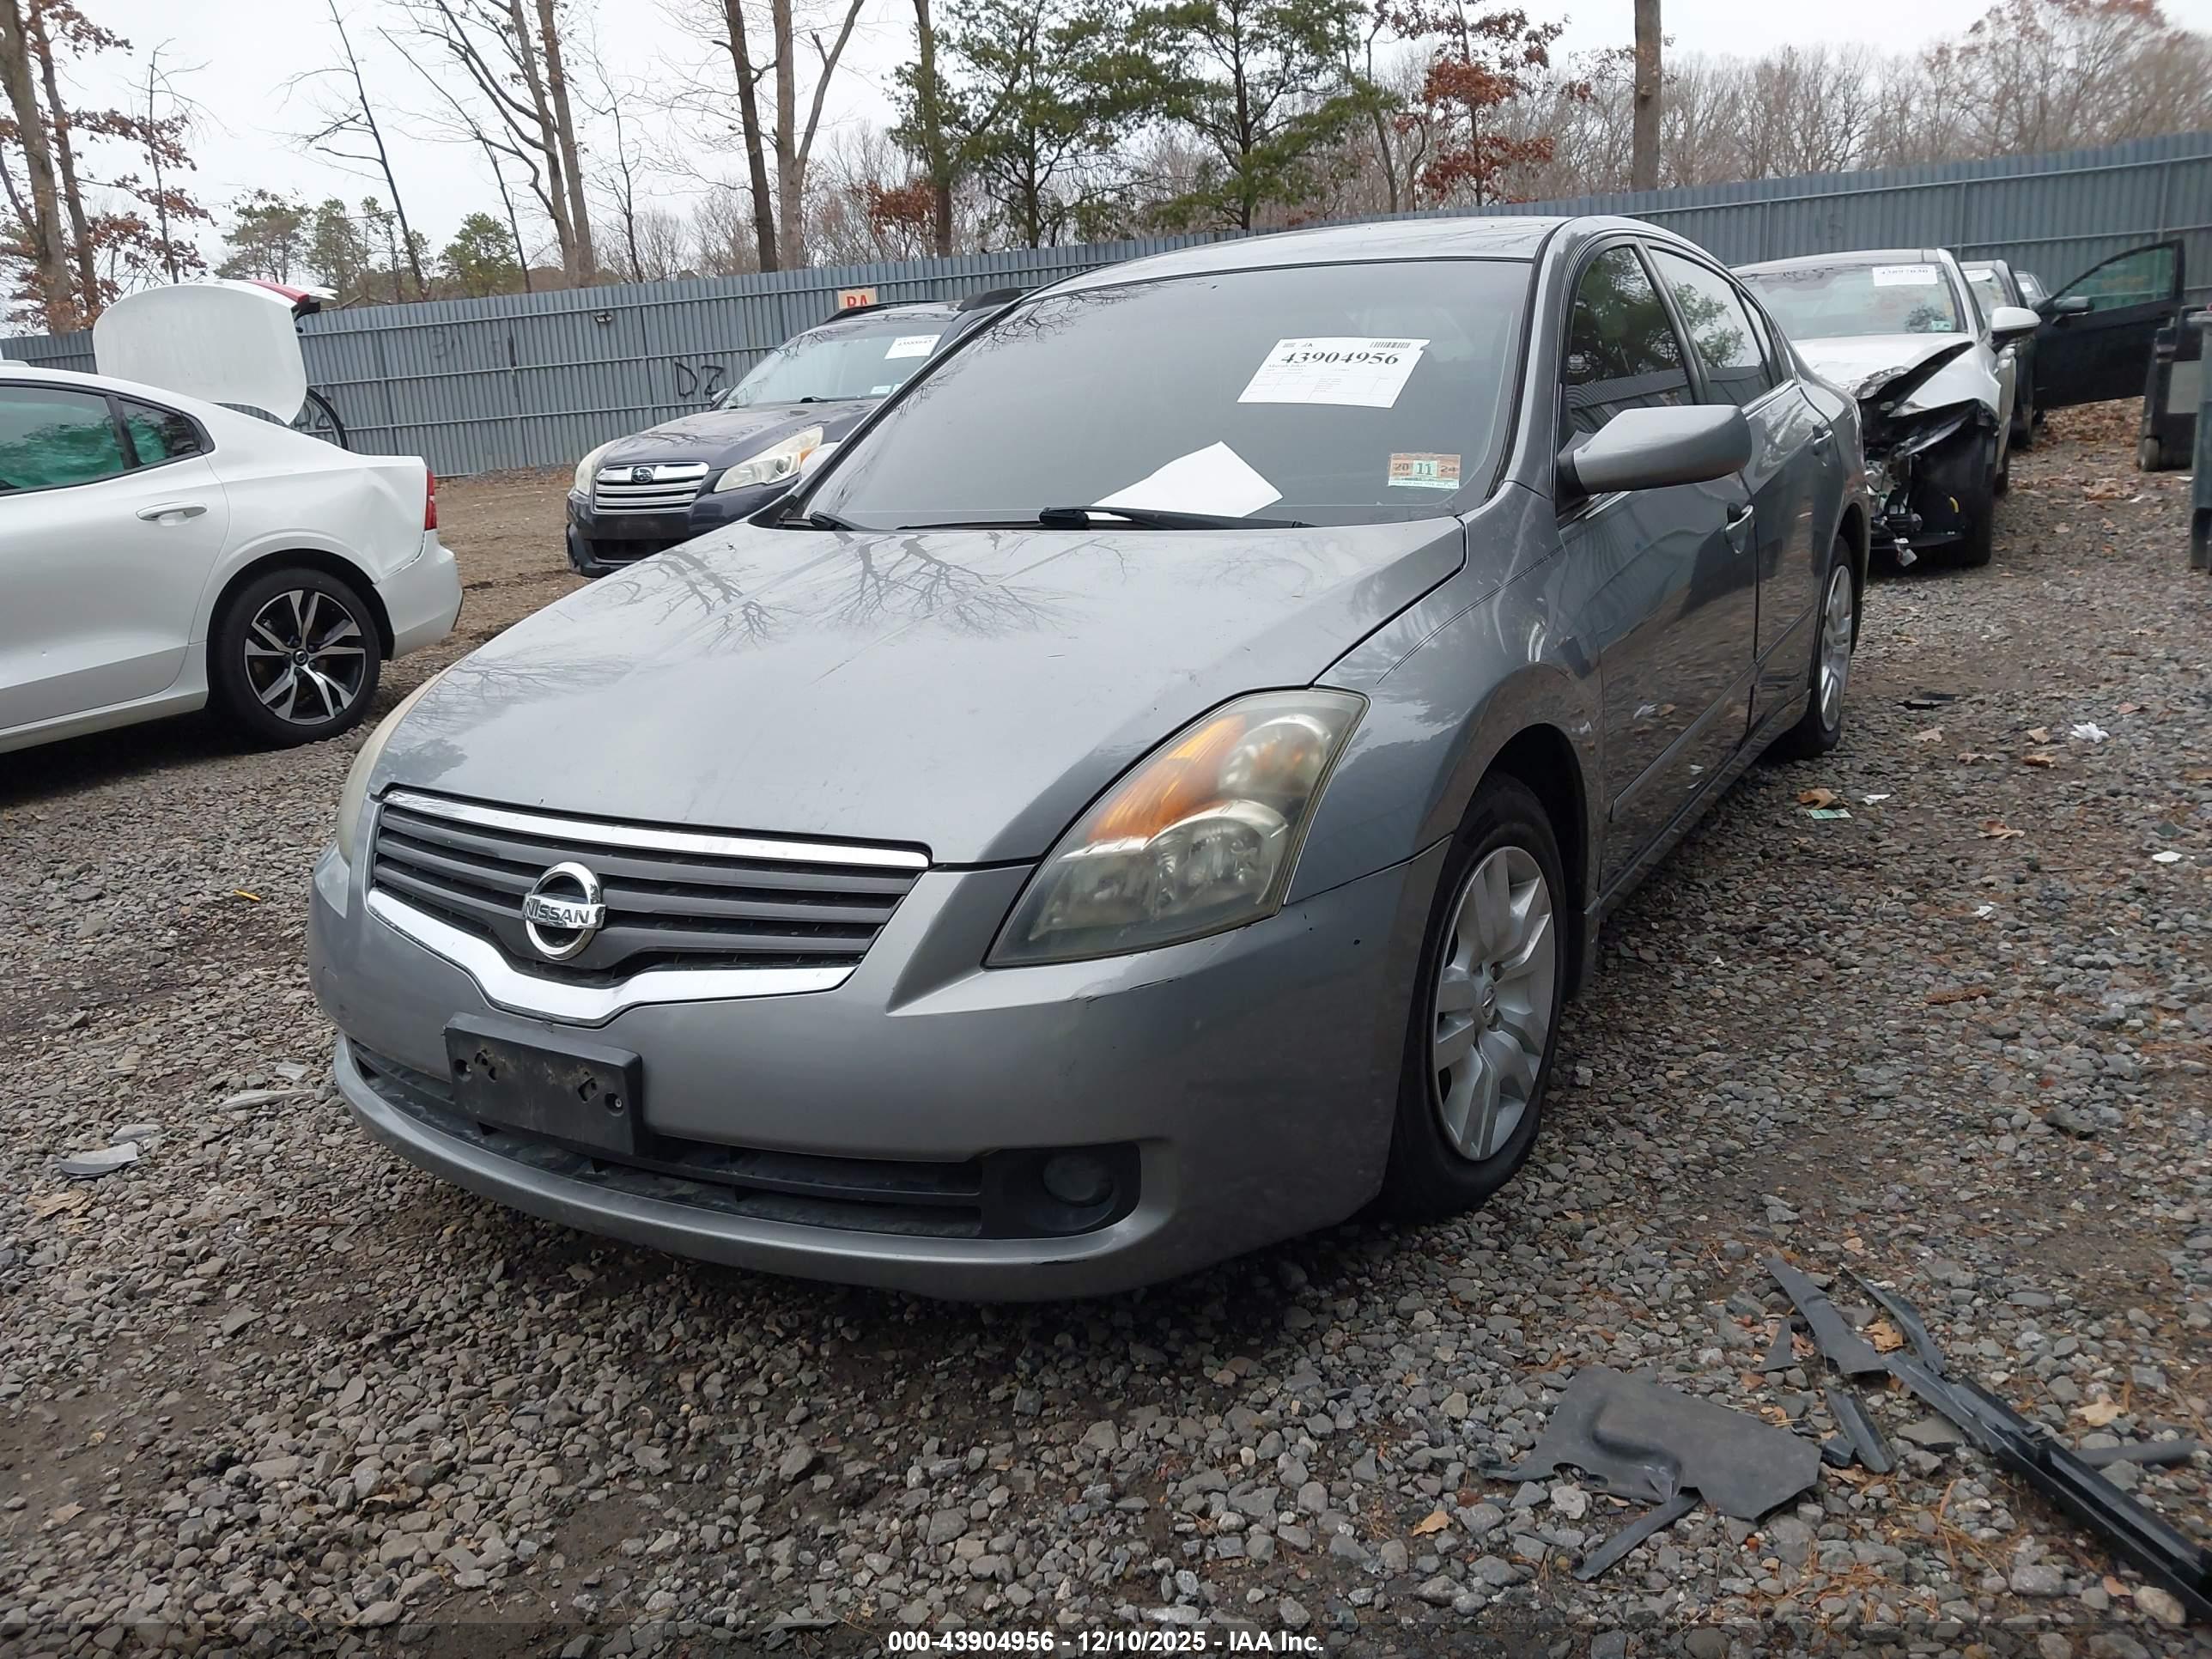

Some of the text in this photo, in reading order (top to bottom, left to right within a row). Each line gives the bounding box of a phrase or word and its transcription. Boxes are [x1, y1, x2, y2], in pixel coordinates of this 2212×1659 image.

[1280, 351, 1401, 365] 43904956
[1394, 462, 1409, 471] 20
[1417, 462, 1433, 476] 11
[526, 897, 590, 924] NISSAN
